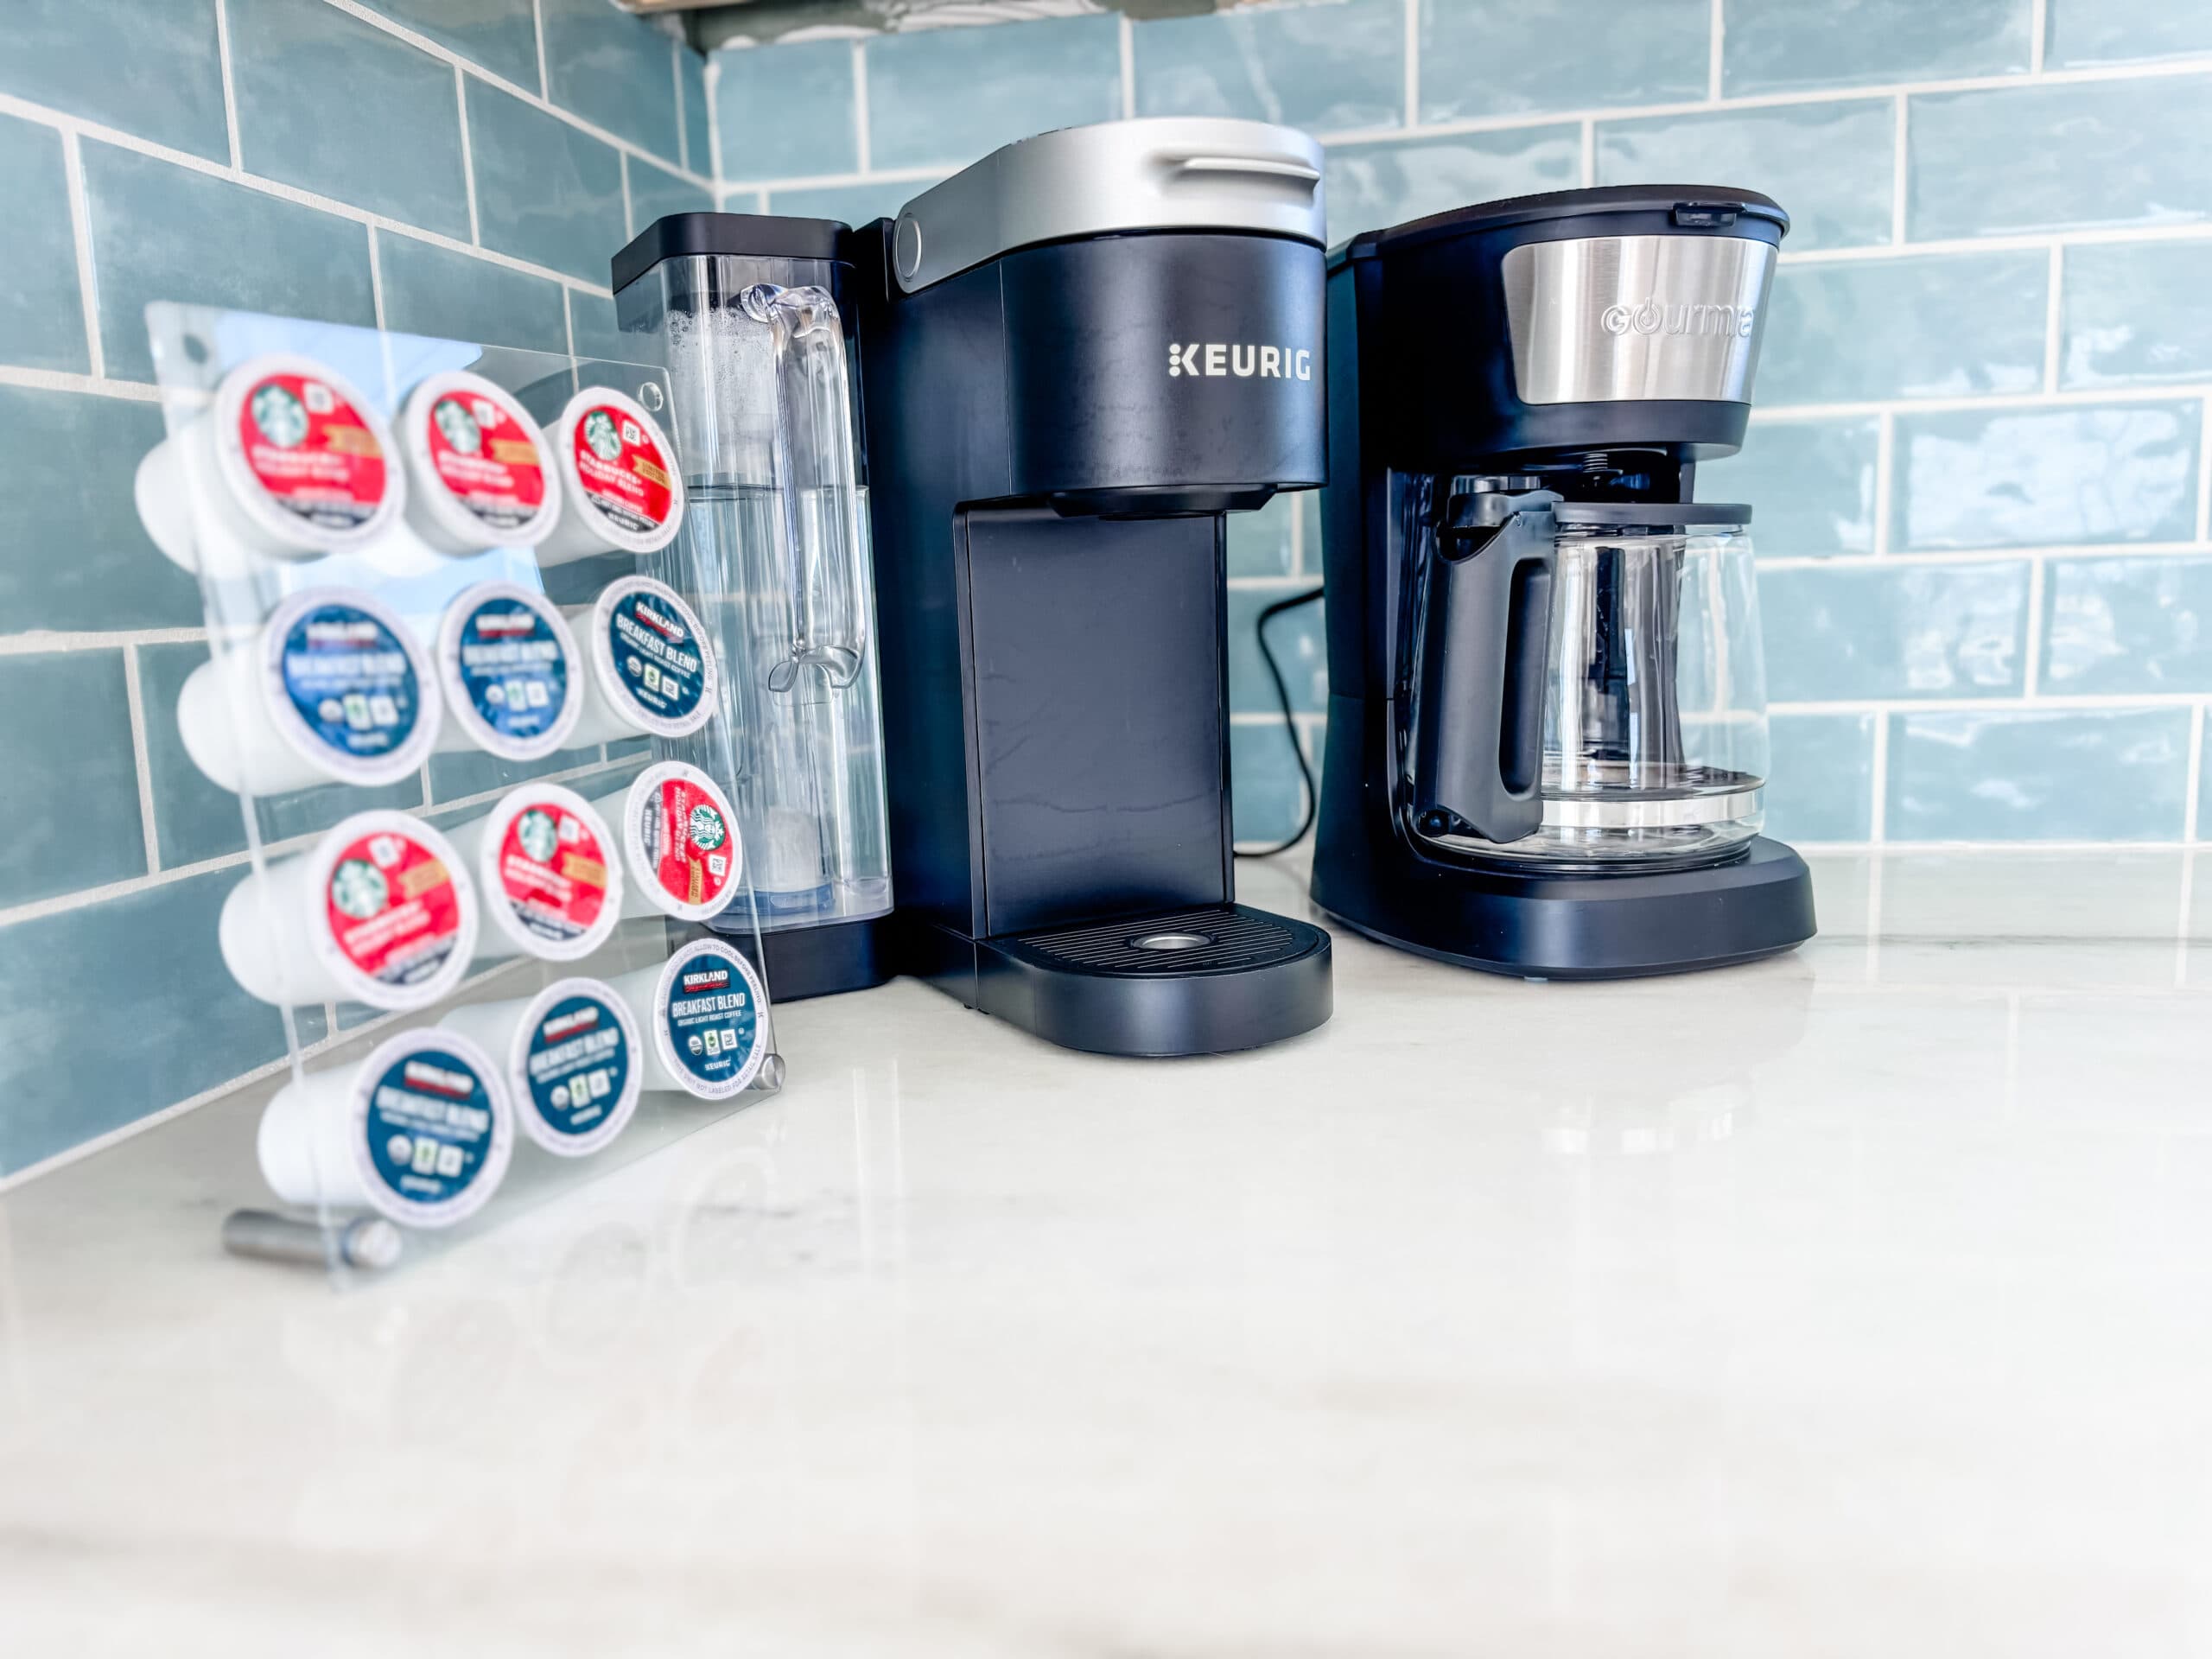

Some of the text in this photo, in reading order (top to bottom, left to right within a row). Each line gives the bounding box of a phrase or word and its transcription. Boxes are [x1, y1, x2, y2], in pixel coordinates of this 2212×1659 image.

[1169, 344, 1311, 380] KEURIG
[635, 601, 684, 638] KIRKLAND
[616, 613, 666, 655] BREAKFAST
[665, 646, 697, 672] BLEND
[683, 969, 728, 985] KIRKLAND
[672, 993, 746, 1019] BREAKFAST BLEND
[724, 1010, 742, 1020] COFFEE
[704, 1059, 731, 1071] KEURIG
